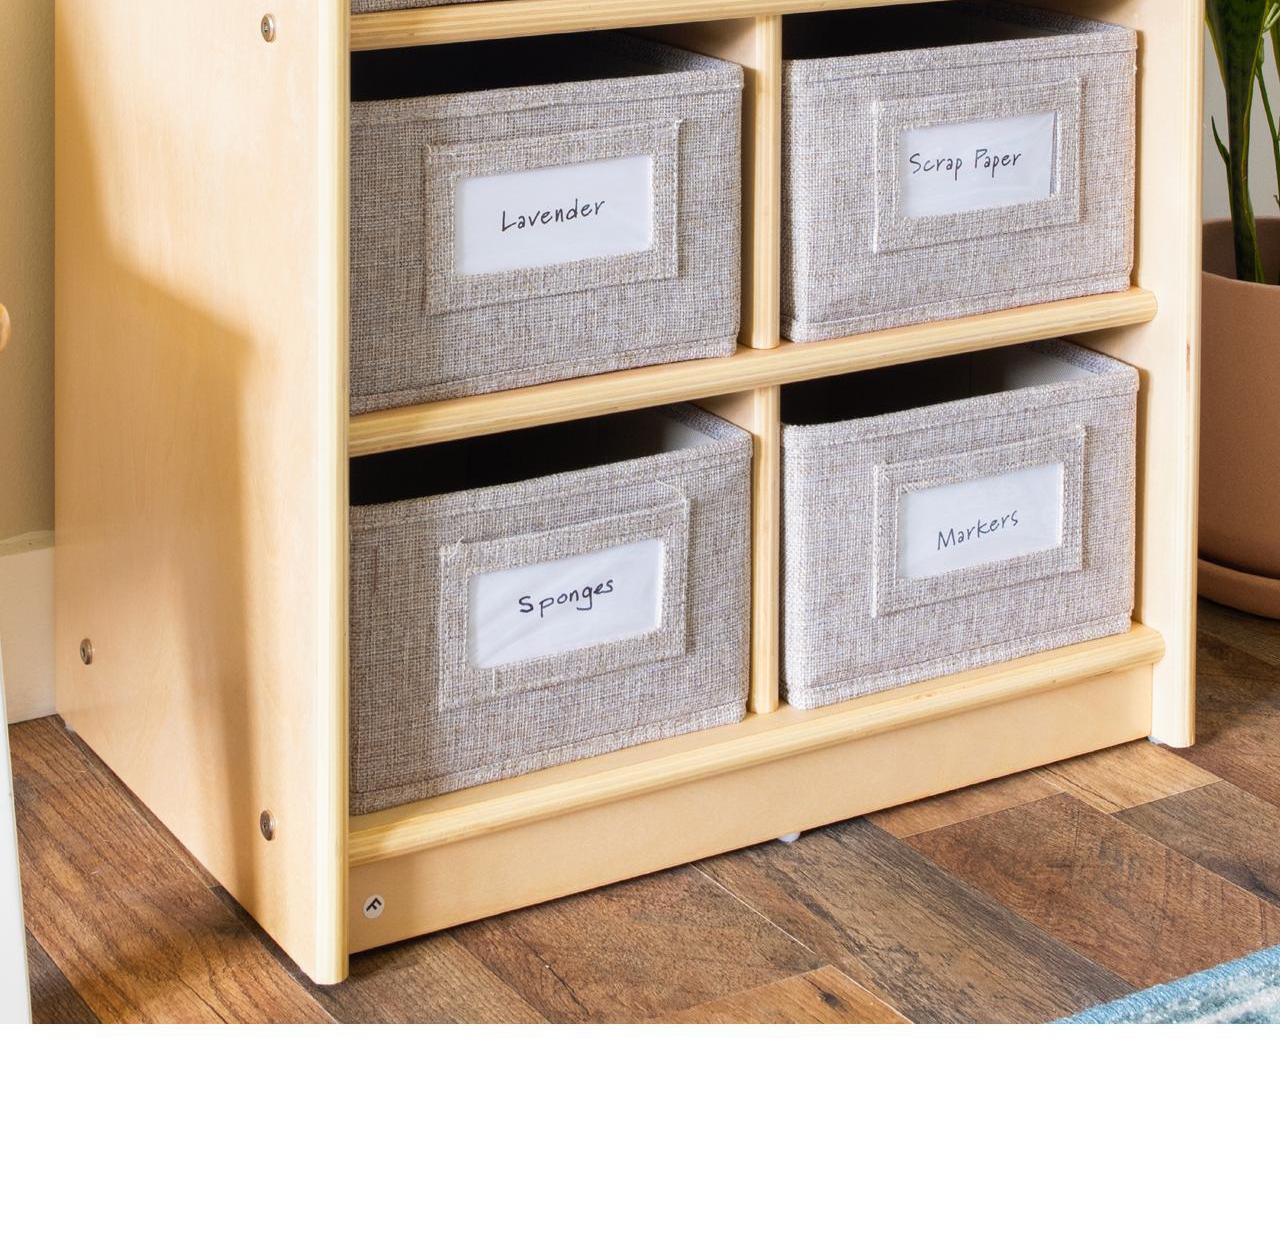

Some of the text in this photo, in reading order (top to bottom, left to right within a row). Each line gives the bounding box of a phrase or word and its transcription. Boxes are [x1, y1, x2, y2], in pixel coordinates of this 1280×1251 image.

[909, 148, 1022, 181] Scrap Paper
[501, 198, 606, 232] Lavender
[937, 510, 1019, 551] Markers
[518, 579, 614, 618] Sponges
[366, 897, 382, 912] F
